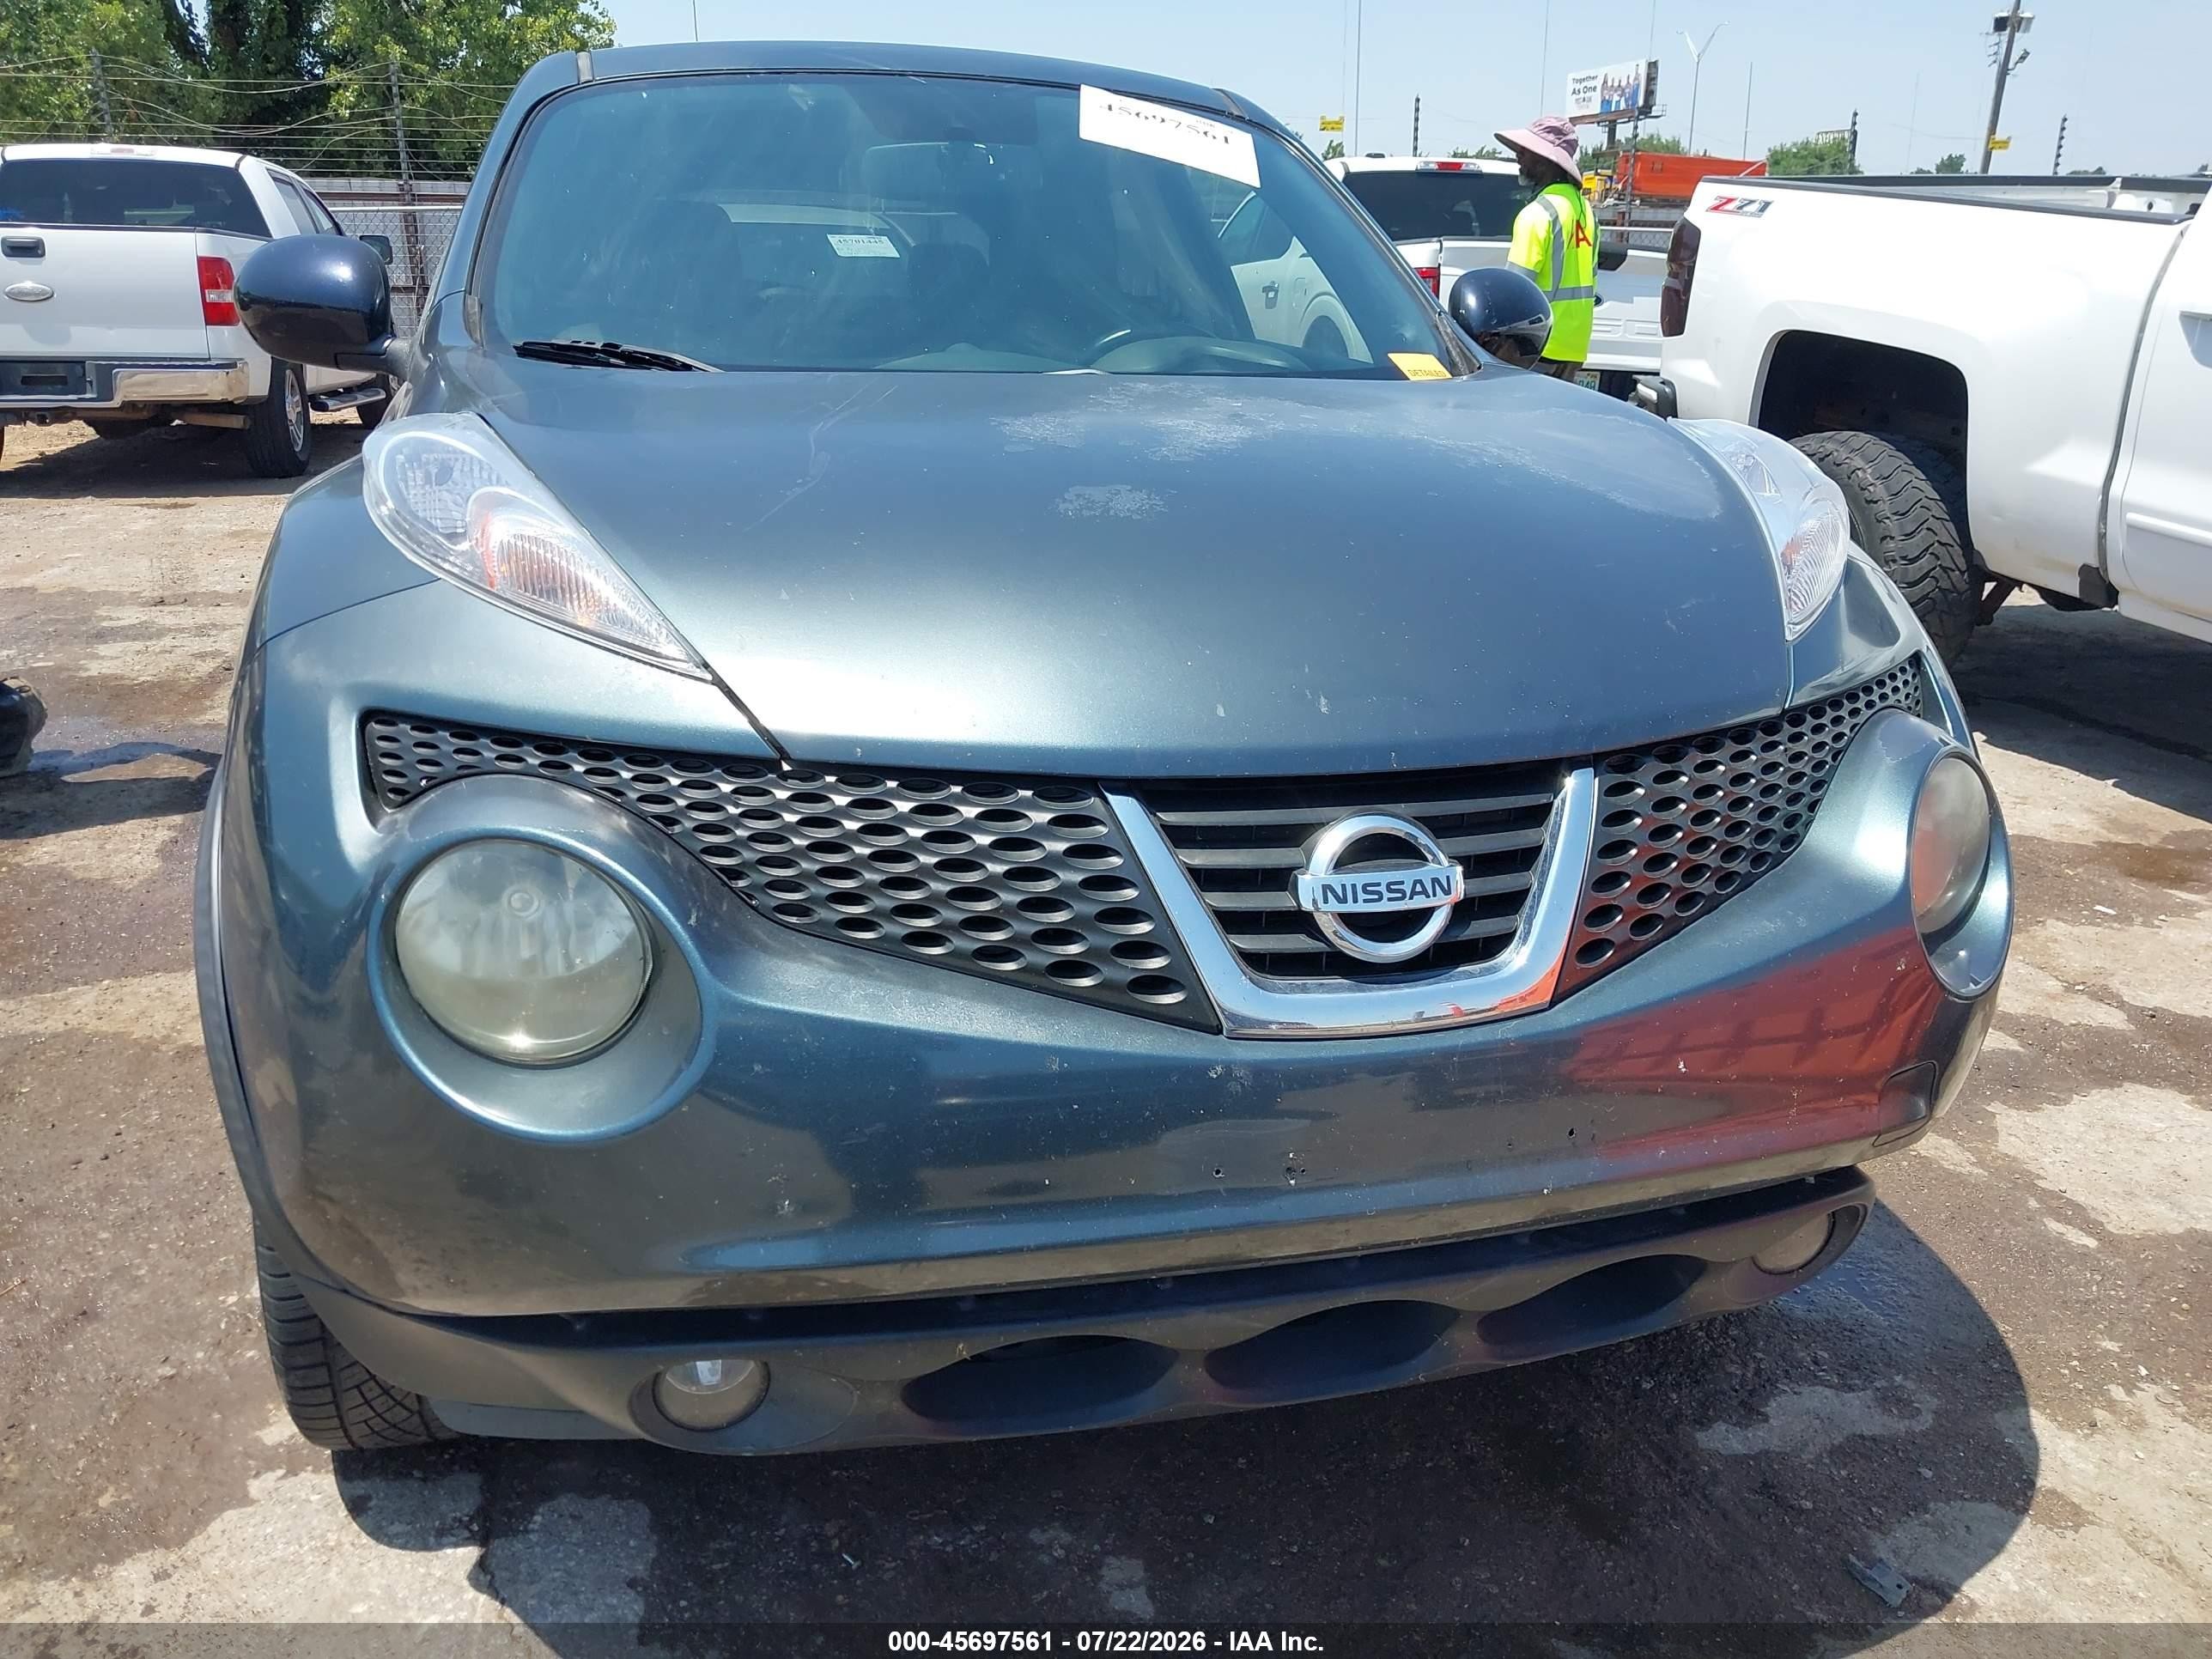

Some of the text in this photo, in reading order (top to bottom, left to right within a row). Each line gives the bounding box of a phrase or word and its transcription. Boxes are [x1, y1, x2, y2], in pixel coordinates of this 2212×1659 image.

[1572, 75, 1598, 85] Together
[1583, 85, 1597, 94] One
[1705, 195, 1774, 218] Z71
[1321, 875, 1452, 905] NISSAN
